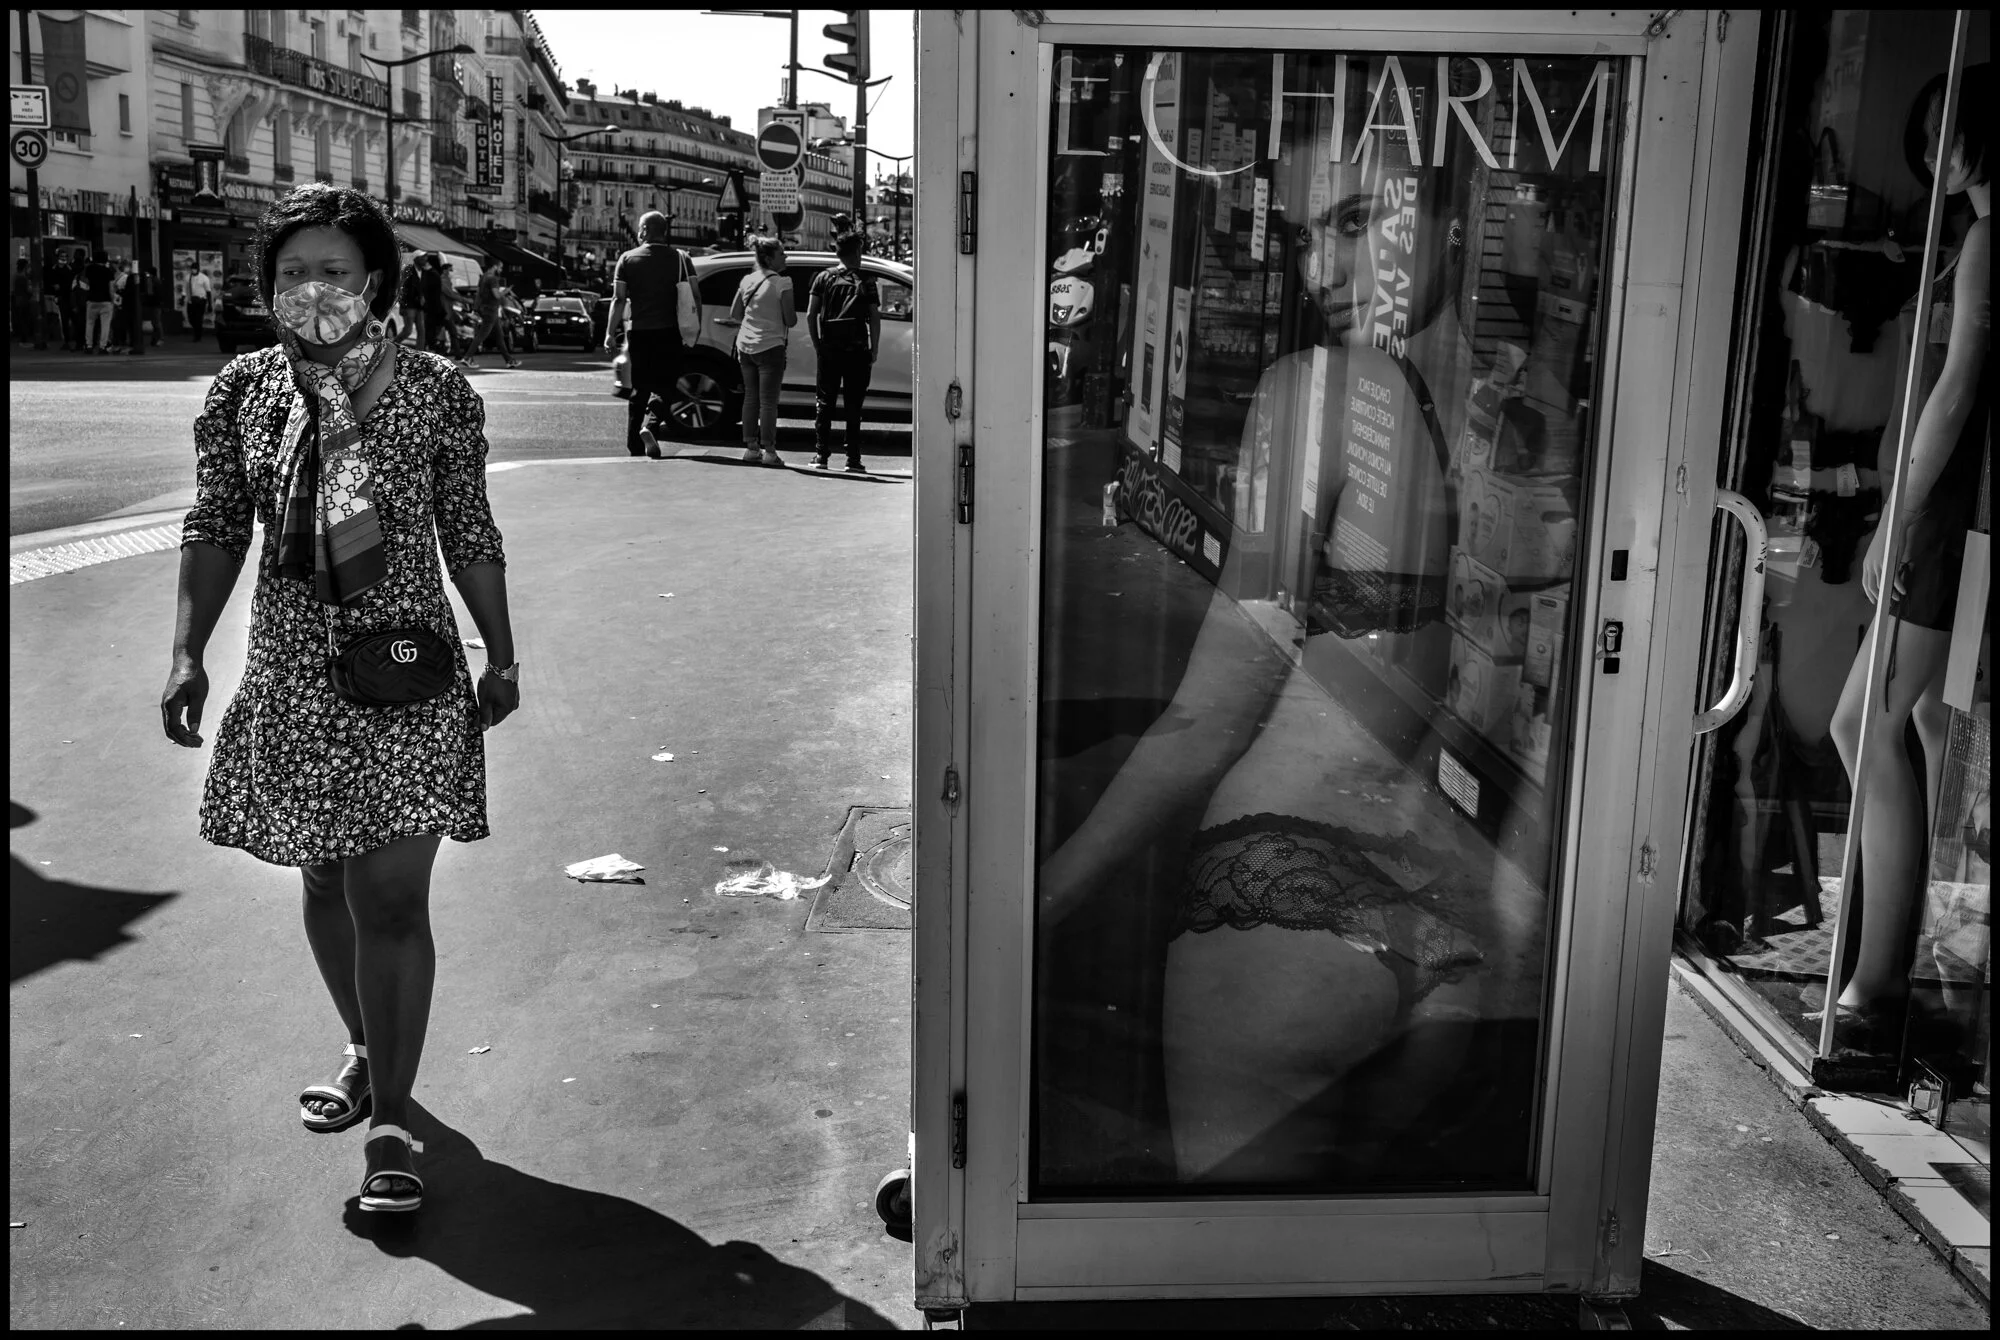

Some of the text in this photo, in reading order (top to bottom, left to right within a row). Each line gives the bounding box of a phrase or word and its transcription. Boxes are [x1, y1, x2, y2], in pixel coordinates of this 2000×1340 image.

[18, 140, 41, 158] 30
[478, 124, 488, 185] HOTEL
[492, 78, 503, 178] NEW HOTEL
